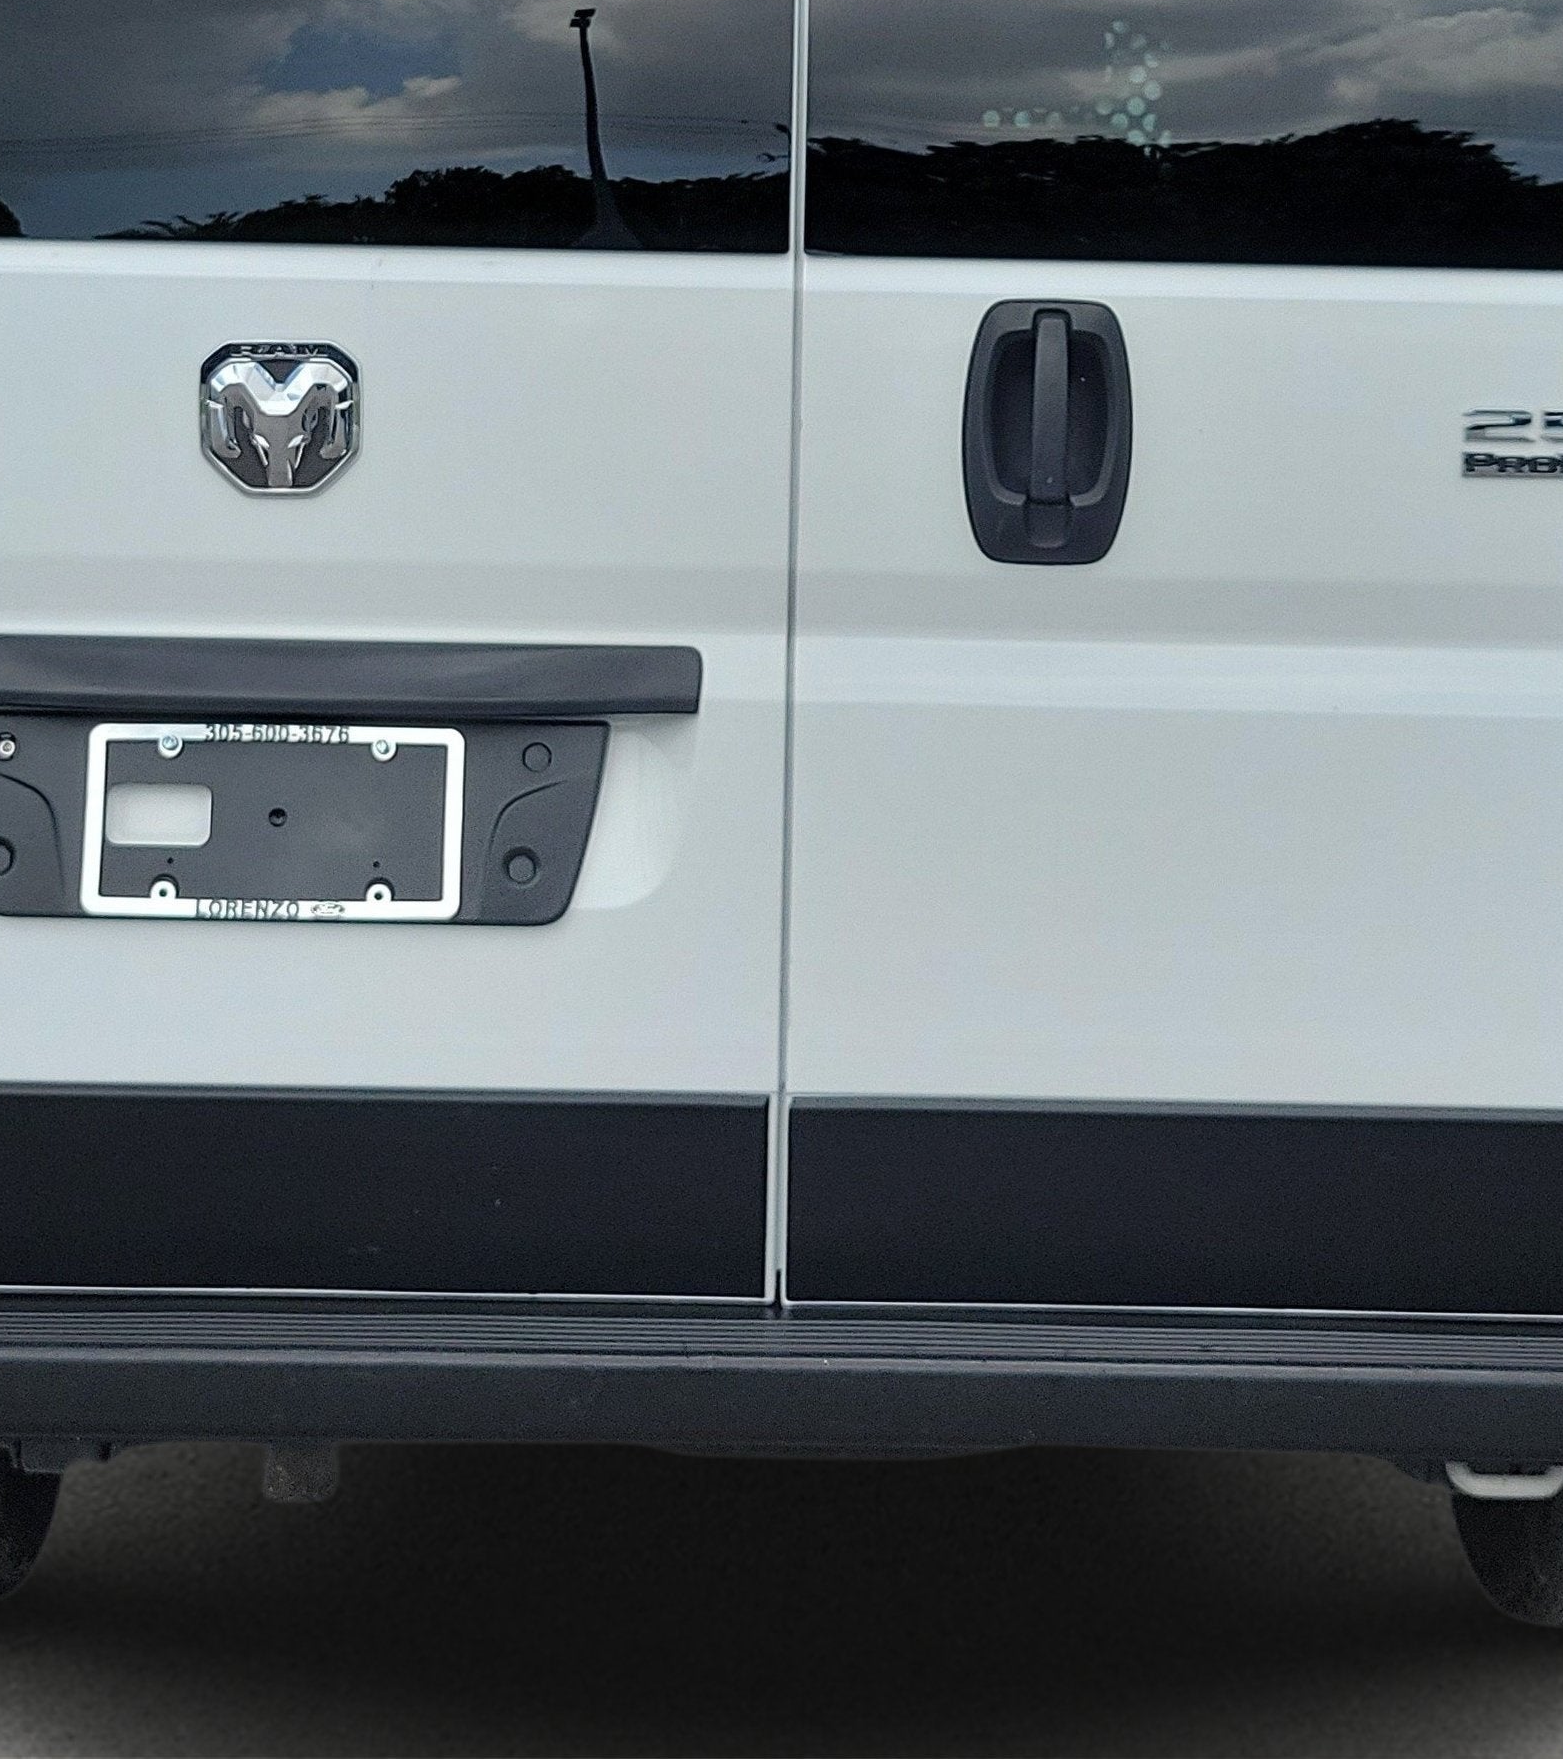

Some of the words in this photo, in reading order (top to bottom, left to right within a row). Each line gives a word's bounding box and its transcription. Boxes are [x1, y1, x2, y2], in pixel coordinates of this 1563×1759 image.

[232, 343, 327, 357] RAM
[205, 723, 350, 743] 305-600-3676
[196, 899, 300, 920] LORENZO
